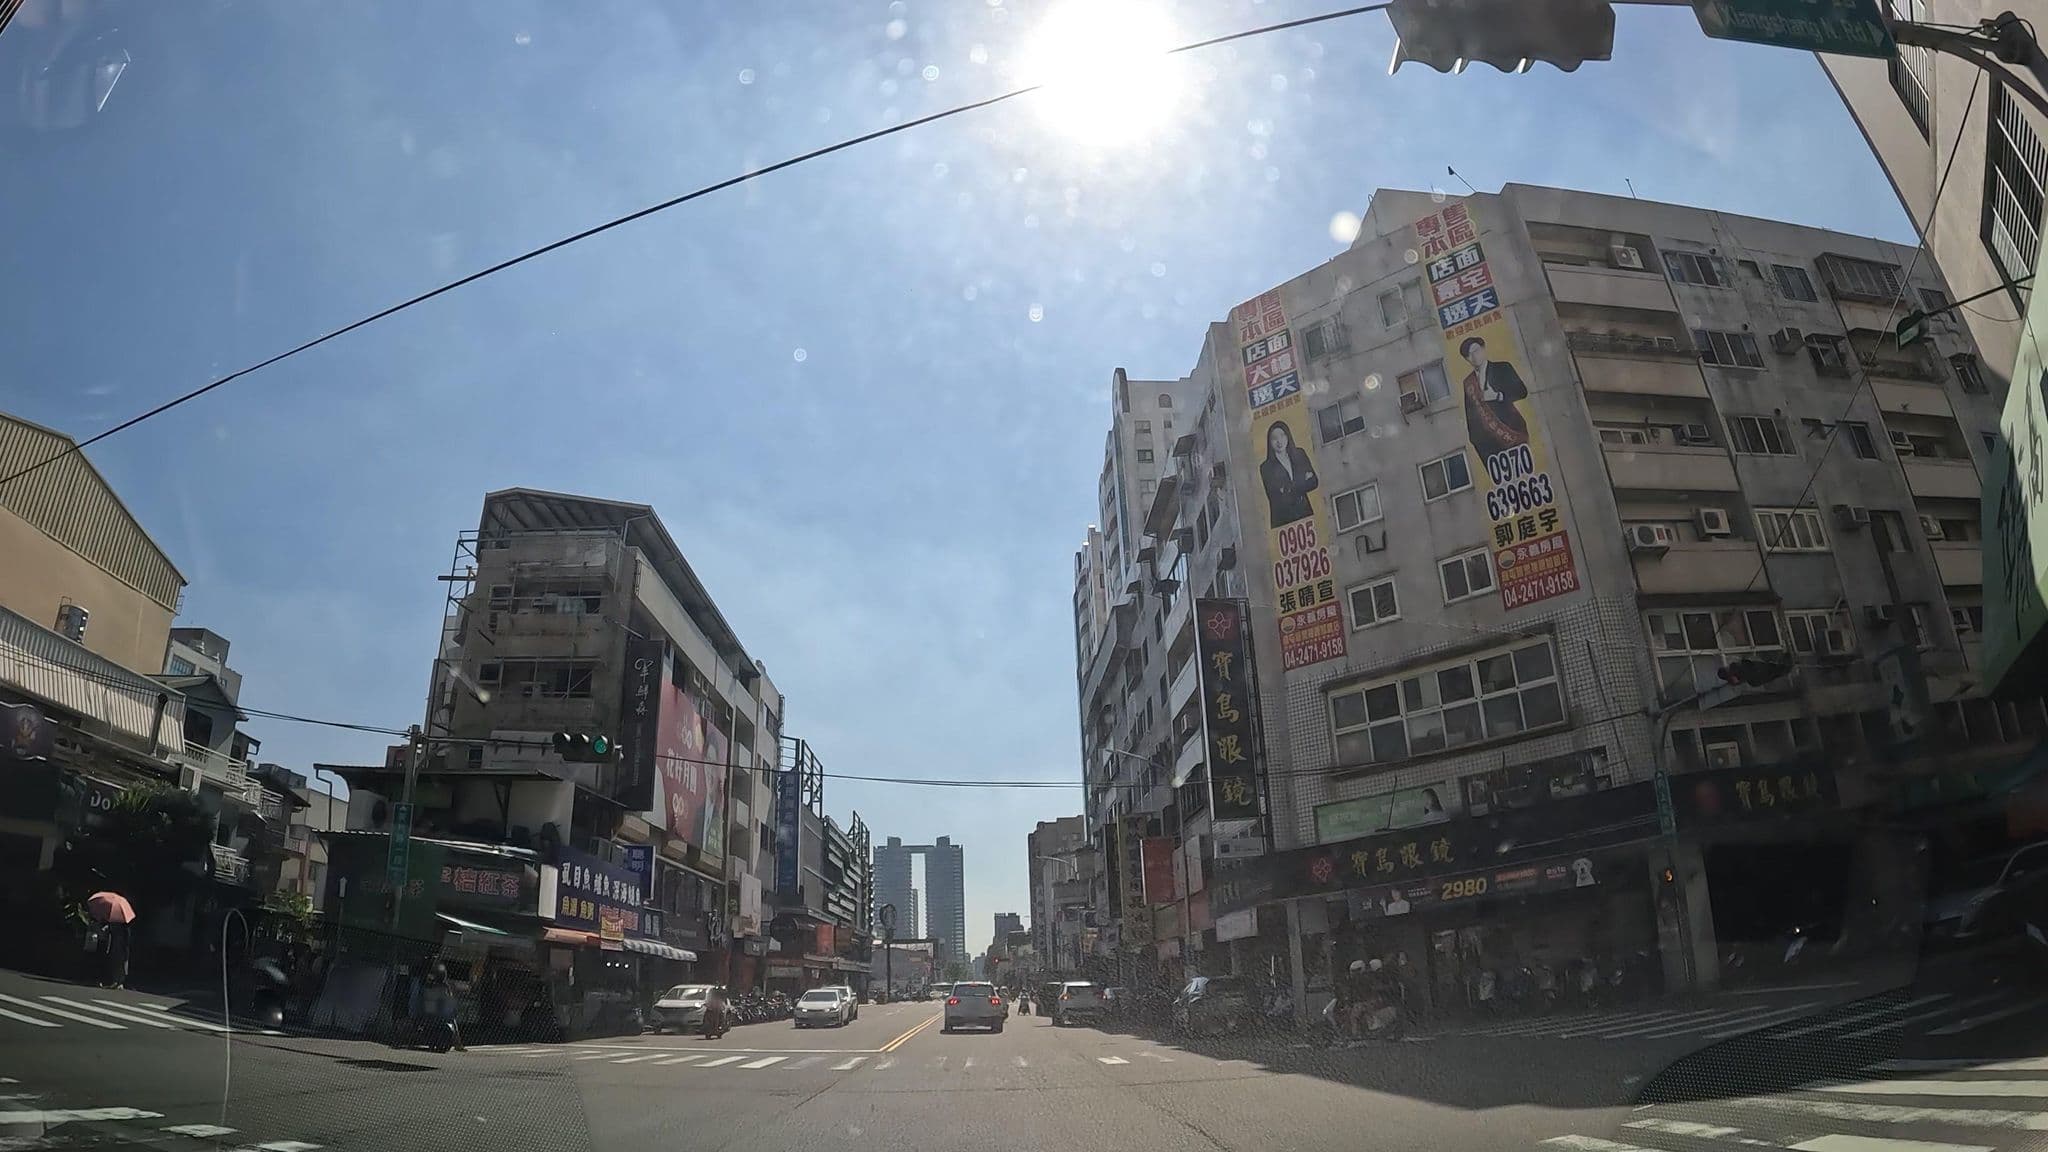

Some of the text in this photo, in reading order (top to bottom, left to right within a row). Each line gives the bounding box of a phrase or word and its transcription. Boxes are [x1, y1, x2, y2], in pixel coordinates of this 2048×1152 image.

[1421, 224, 1476, 259] 本區
[1430, 246, 1481, 281] 店面
[1437, 268, 1488, 302] 豪宅
[1443, 290, 1496, 325] 透天
[1241, 310, 1286, 343] 本區
[1246, 331, 1289, 364] 店面
[1253, 374, 1297, 407] 透天
[1488, 445, 1534, 485] 0970
[1487, 473, 1553, 521] 639663
[1279, 521, 1316, 557] 0905
[1274, 547, 1331, 589] 037926
[1280, 581, 1335, 615] 張晴宣
[1504, 570, 1575, 608] 04-2471-9158
[1284, 638, 1344, 669] 04-2471-9158
[1211, 650, 1251, 807] 寶島眼鏡
[1350, 838, 1455, 878] 寶島眼鏡
[1441, 876, 1487, 901] 2980
